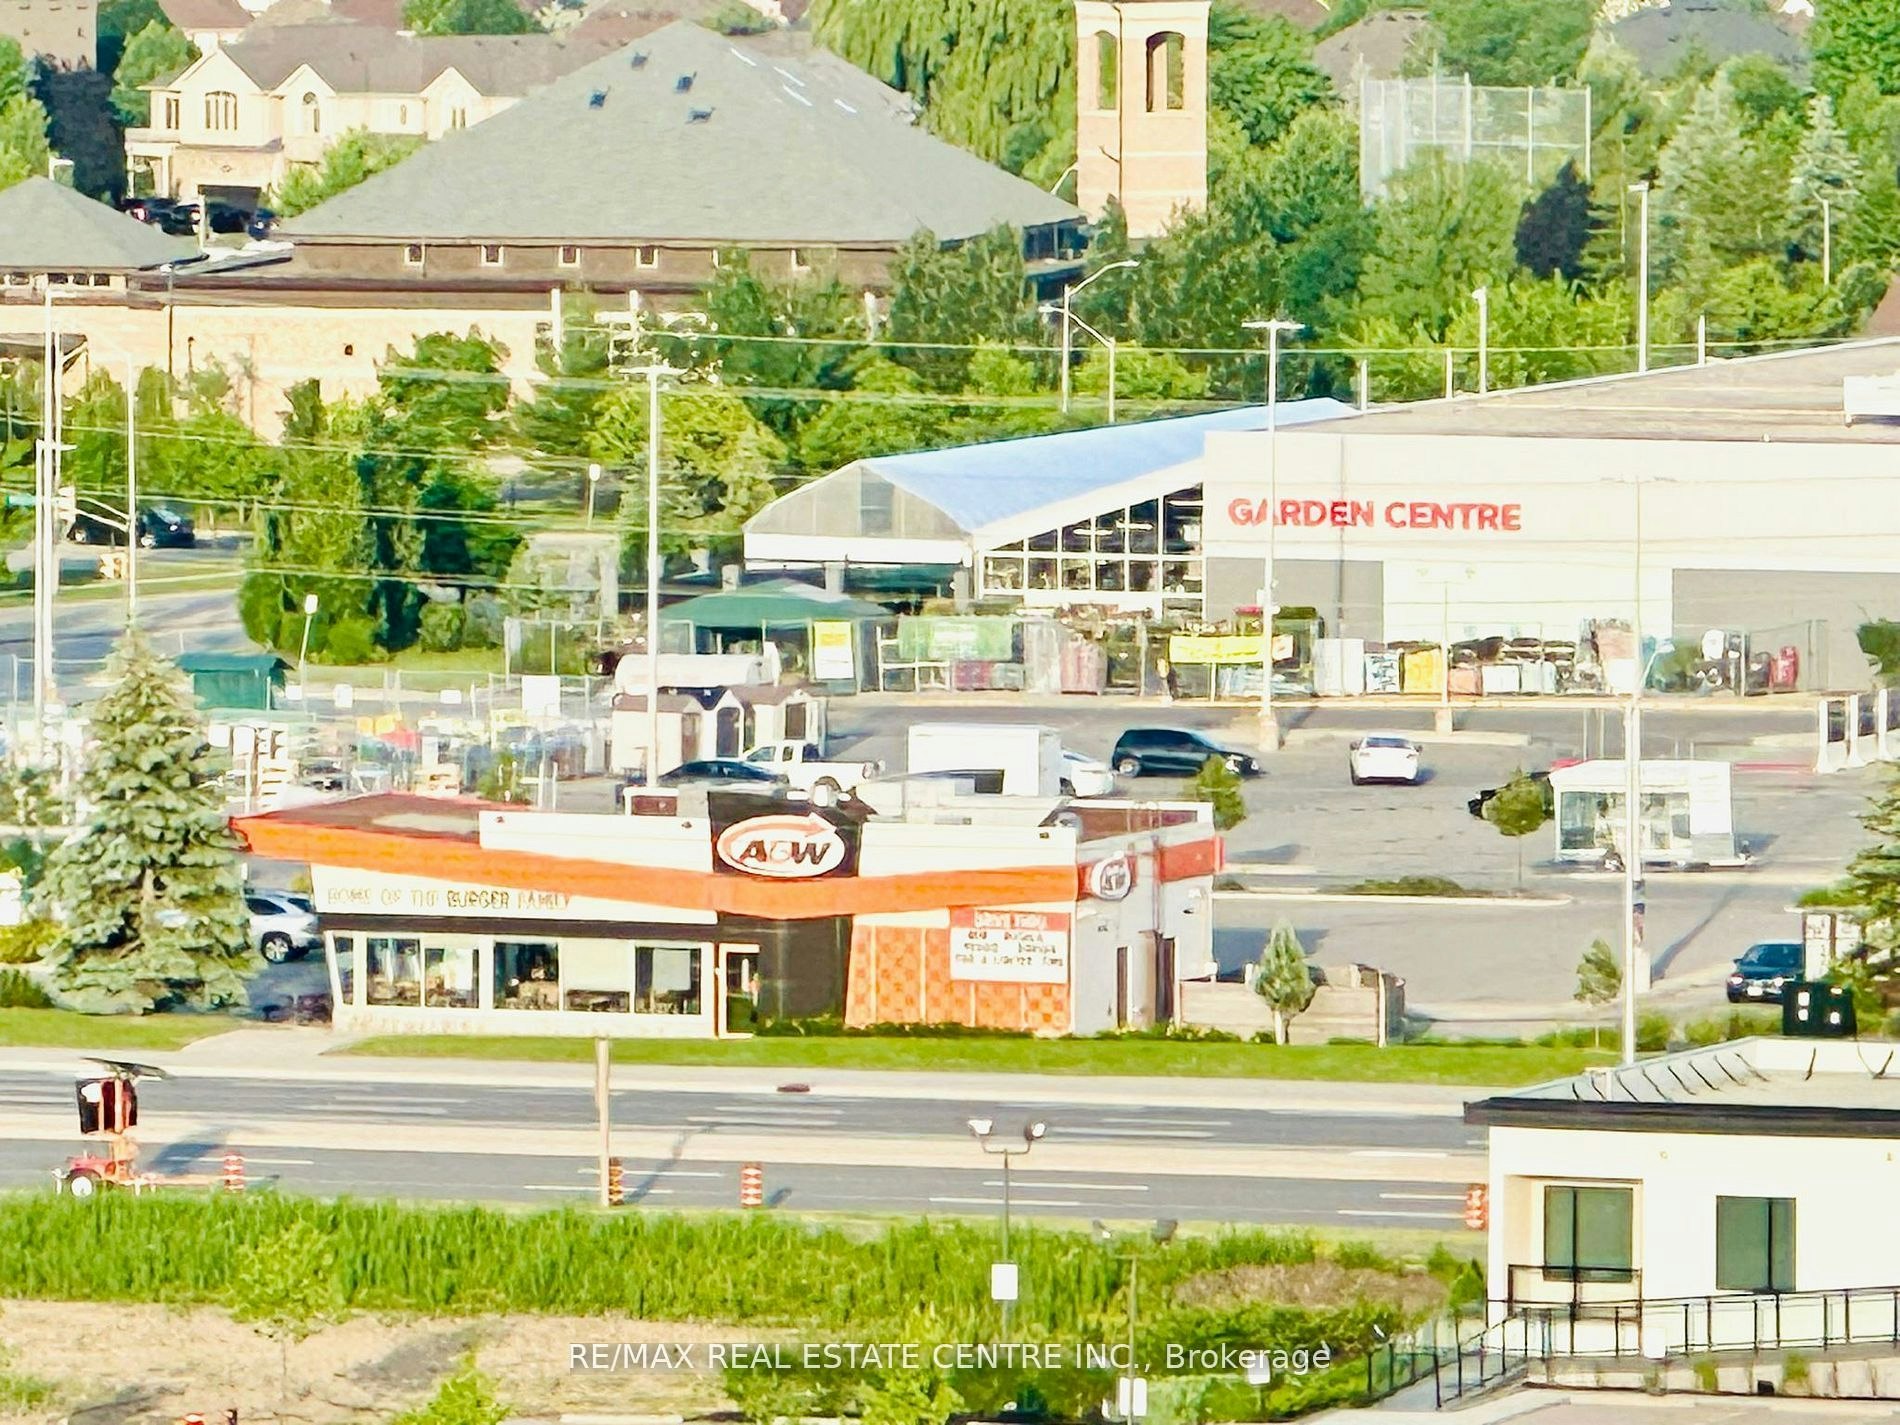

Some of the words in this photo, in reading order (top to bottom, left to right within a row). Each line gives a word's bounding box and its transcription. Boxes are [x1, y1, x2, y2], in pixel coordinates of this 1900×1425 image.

[1227, 497, 1375, 528] GARDEN
[1384, 501, 1522, 531] CENTRE
[739, 839, 832, 865] A&W
[447, 890, 510, 909] BURGER
